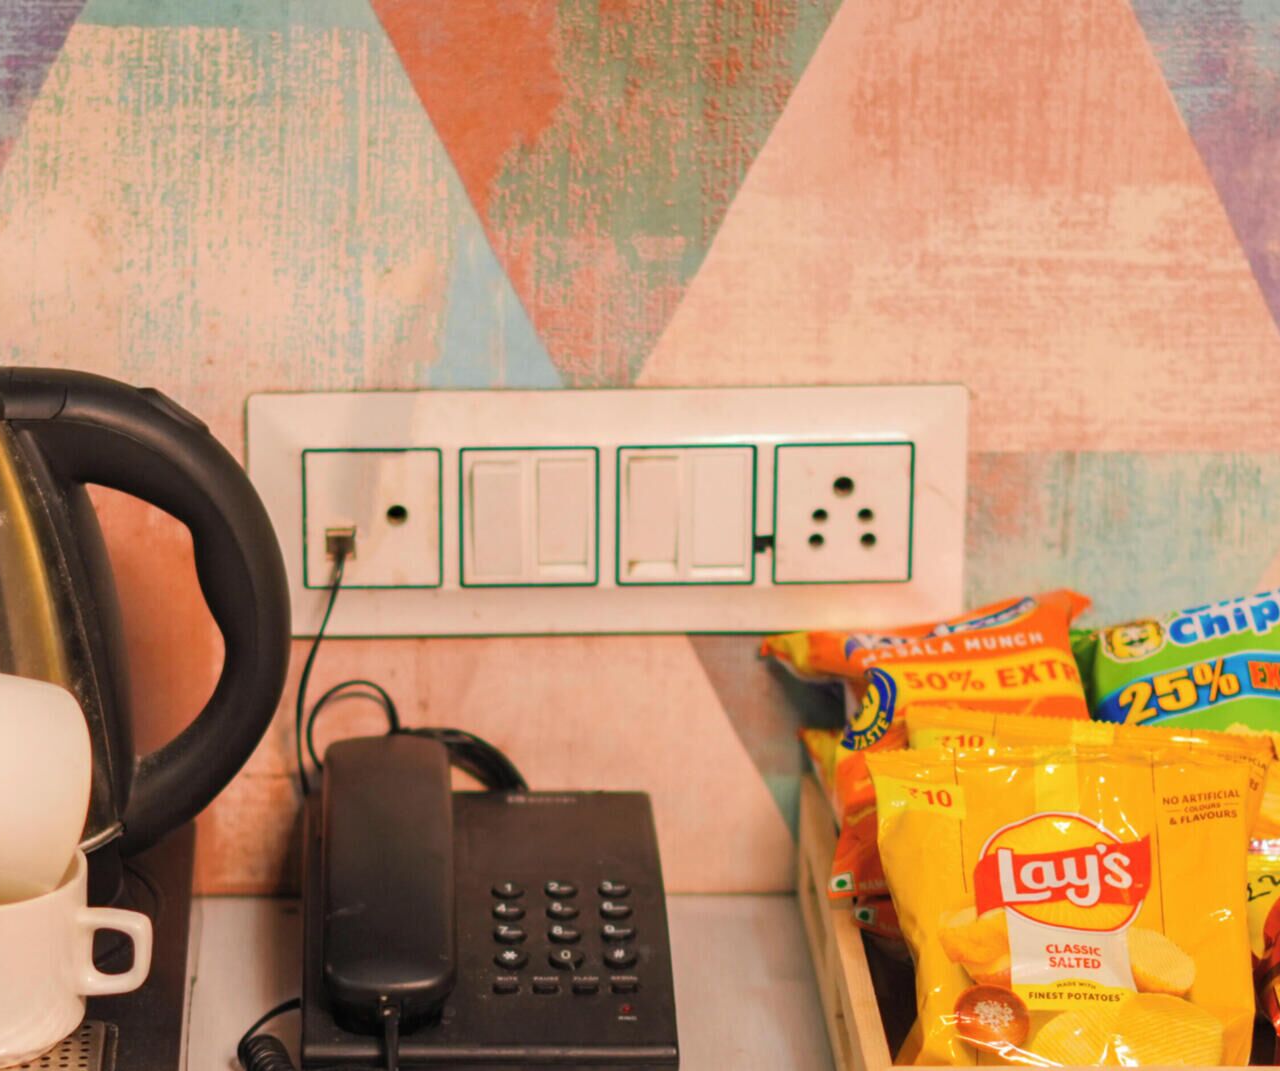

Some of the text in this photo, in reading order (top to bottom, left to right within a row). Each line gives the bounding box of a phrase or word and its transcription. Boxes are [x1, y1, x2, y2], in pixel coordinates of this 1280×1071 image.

[862, 632, 1044, 667] MASALA MUNCH
[903, 659, 1081, 692] 50% EXTR
[1118, 657, 1241, 726] 25%
[1162, 789, 1240, 806] NO ARTIFICIAL
[1184, 802, 1221, 813] COLOURS
[1180, 810, 1238, 825] FLAVOURS
[997, 843, 1133, 907] Lay's
[1045, 943, 1102, 957] CLASSIC
[1049, 957, 1102, 970] SALTED
[1028, 992, 1121, 1003] FINEST POTATOES
